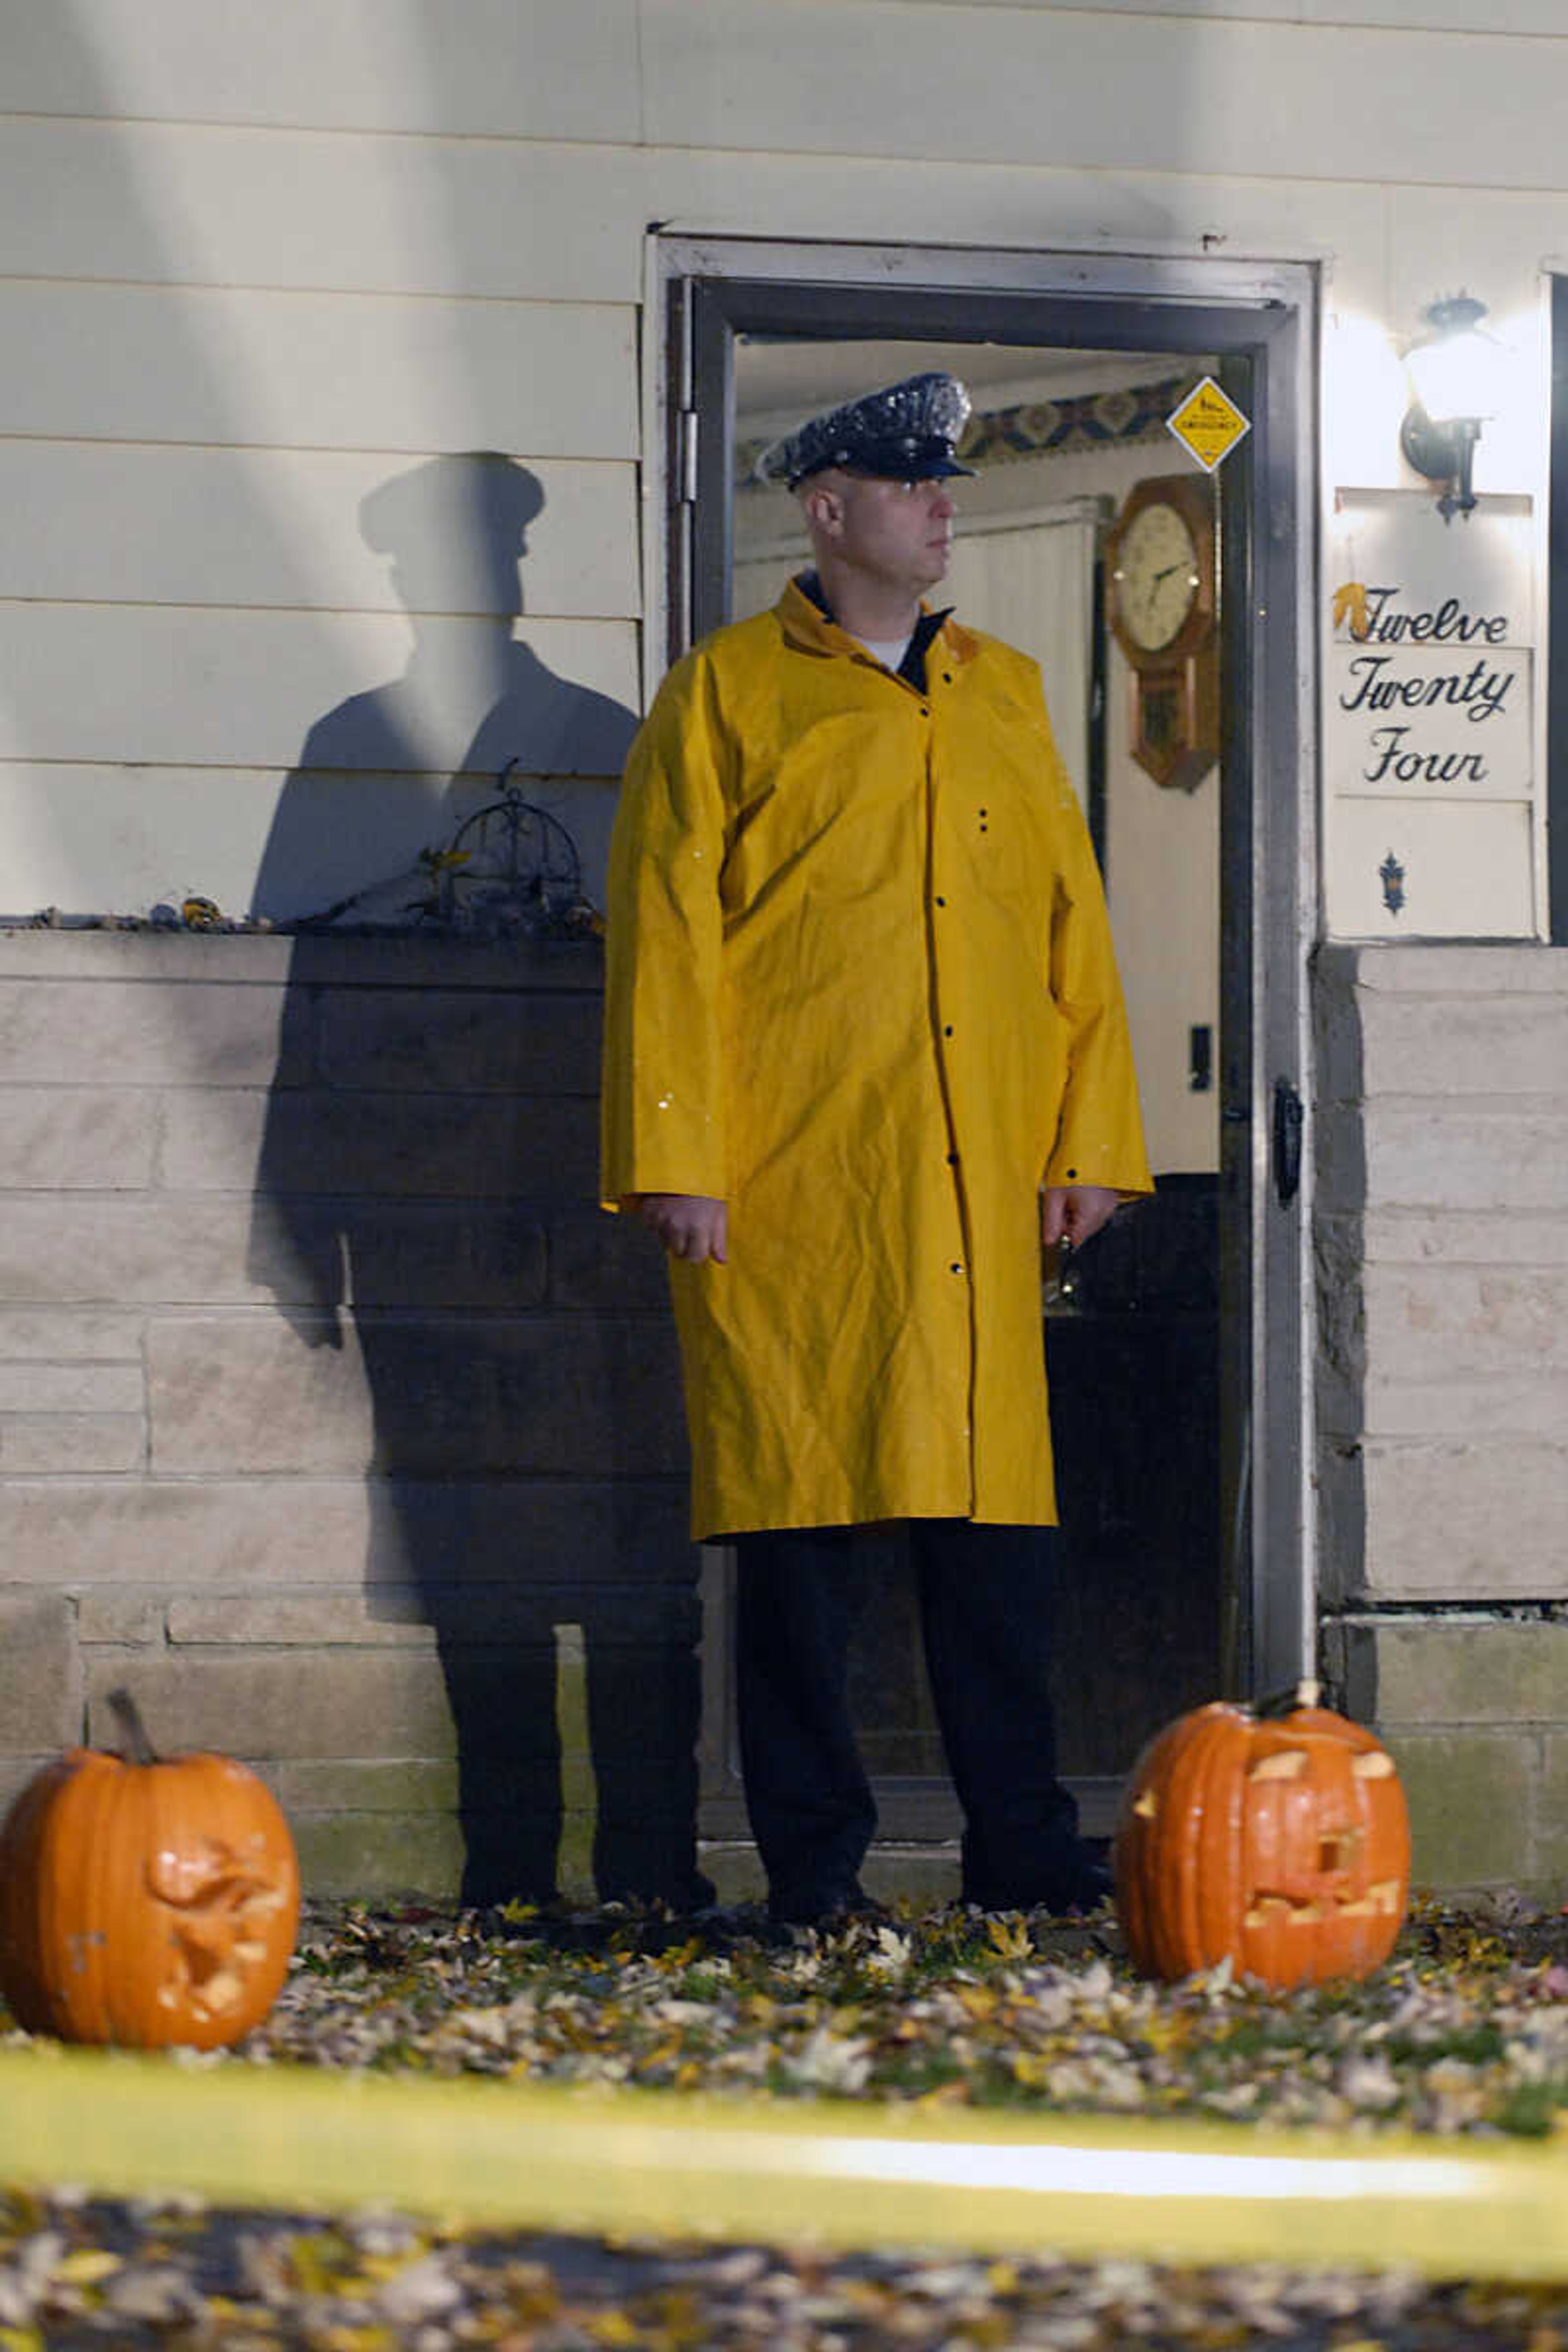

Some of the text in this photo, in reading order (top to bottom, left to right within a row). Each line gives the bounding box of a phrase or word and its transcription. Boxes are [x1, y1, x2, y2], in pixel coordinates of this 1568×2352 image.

[1350, 588, 1507, 643] Twelve
[1340, 657, 1515, 722] Twenty
[1364, 727, 1489, 782] Four
